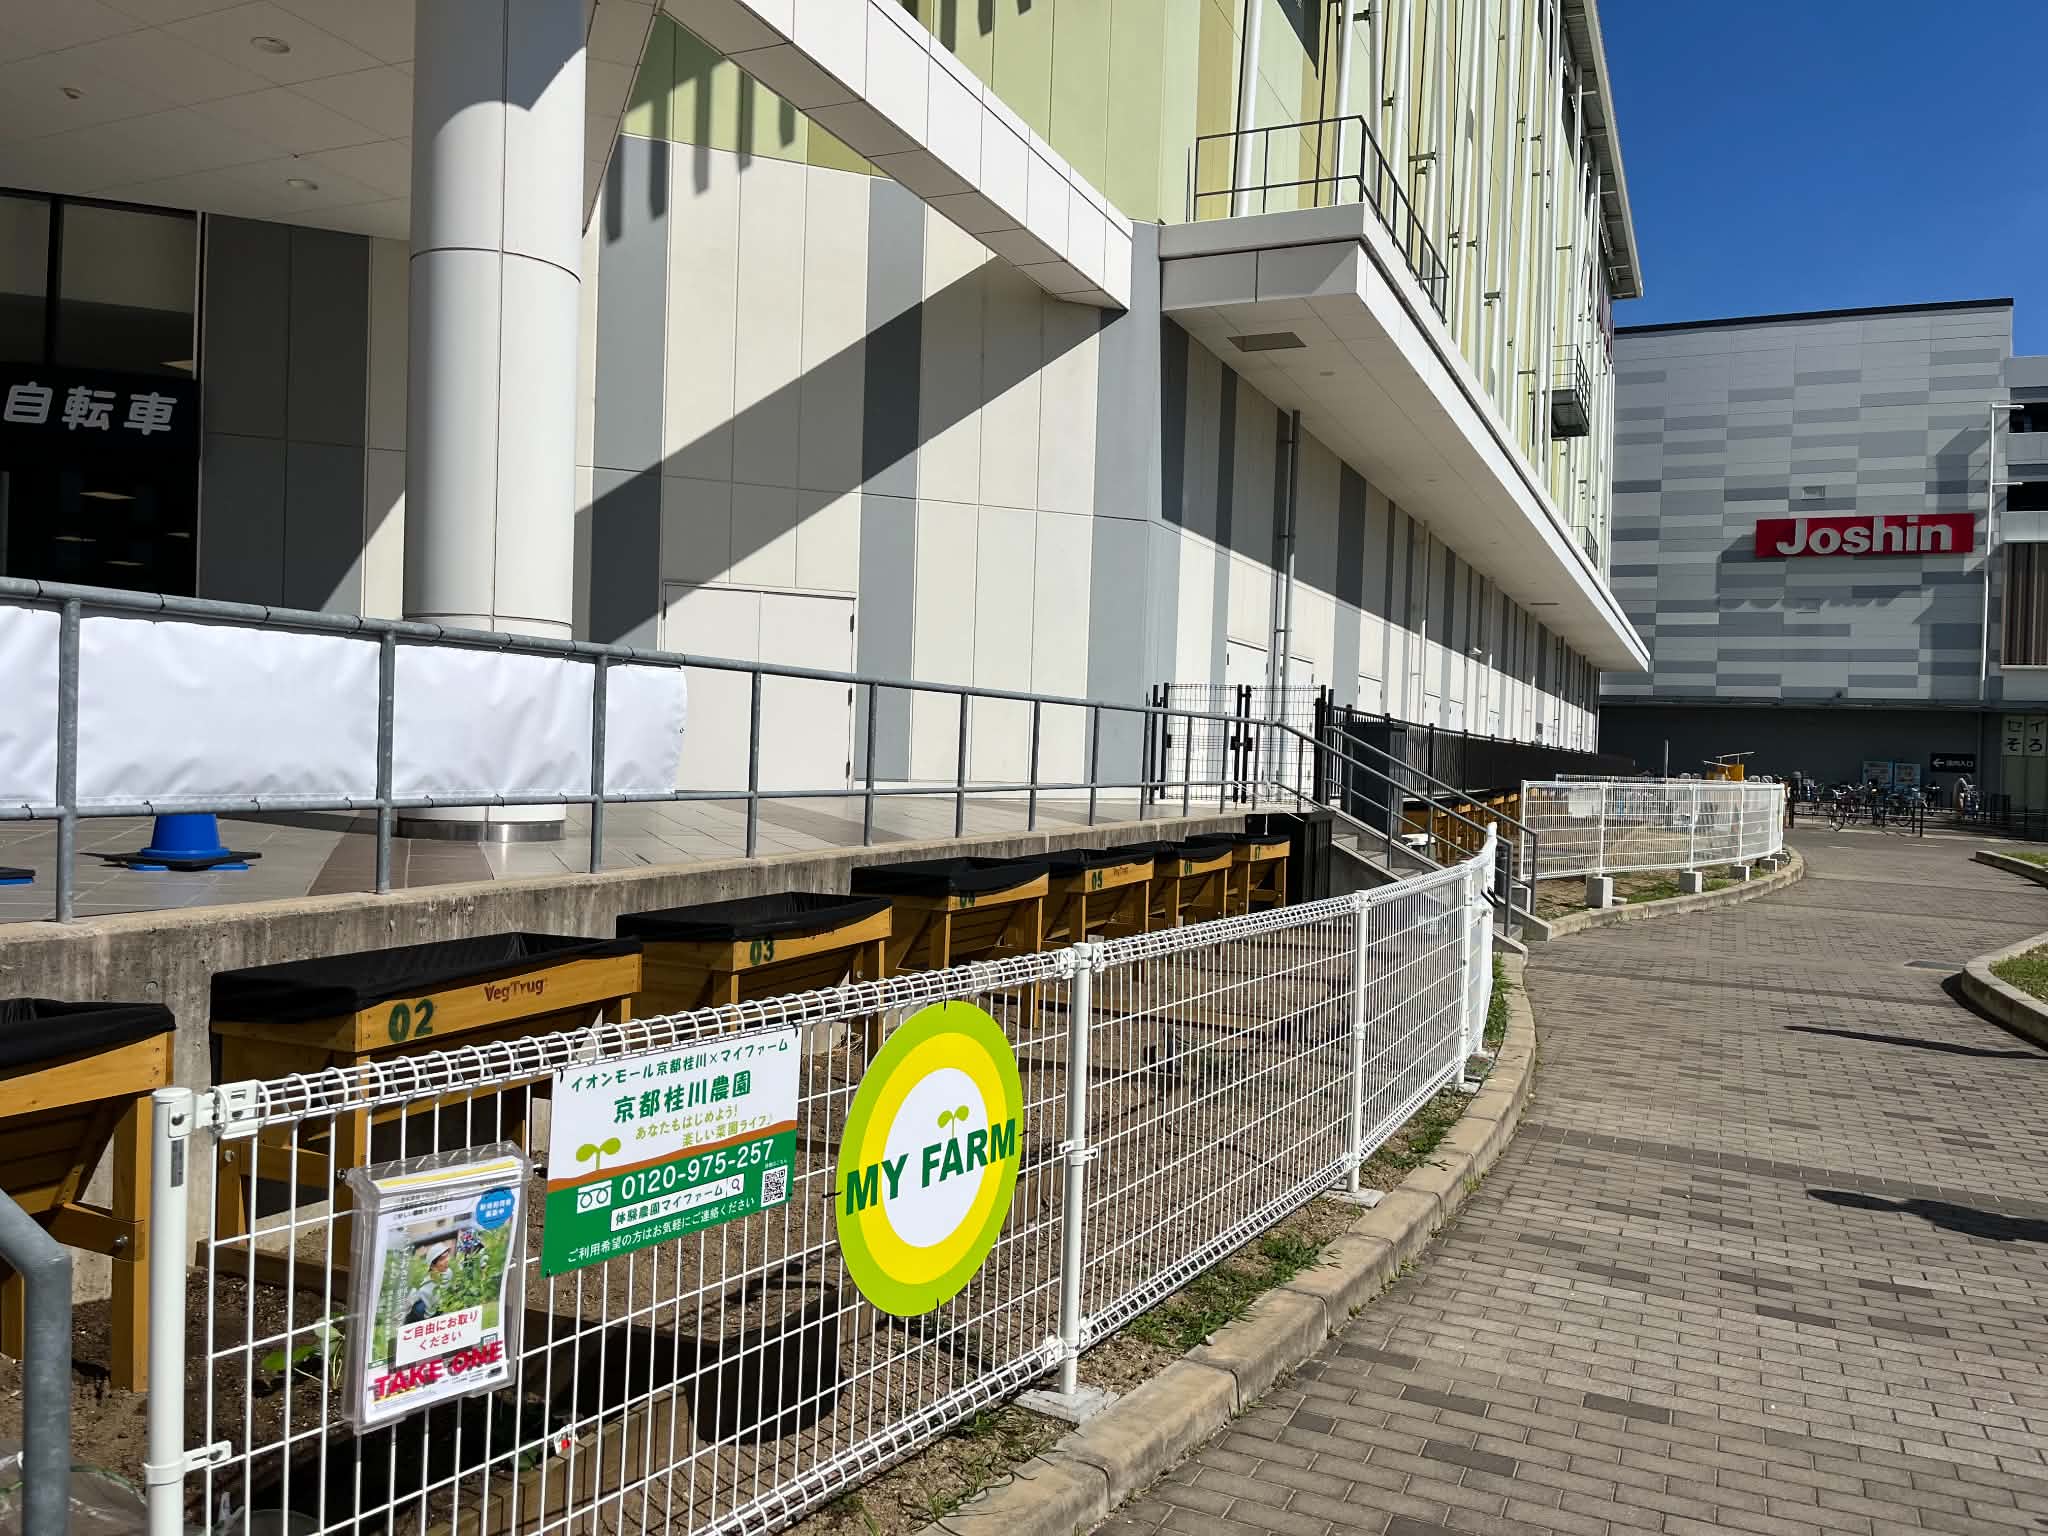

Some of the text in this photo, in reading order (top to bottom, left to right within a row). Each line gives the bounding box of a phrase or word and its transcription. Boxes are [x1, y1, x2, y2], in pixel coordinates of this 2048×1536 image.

[3, 381, 178, 436] 自転車
[1776, 515, 1953, 555] Joshin
[750, 938, 775, 965] 03
[484, 979, 545, 1002] VegTrug
[388, 998, 435, 1042] 02
[571, 1038, 788, 1093] イオンモール京都桂川×マイファーム
[613, 1070, 752, 1124] 京都桂川農園
[635, 1104, 738, 1140] あなたもはじめよう！
[621, 1138, 775, 1200] 0120-975-257
[845, 1118, 1016, 1215] MY FARM
[615, 1185, 723, 1226] 体験農園マイファーム
[567, 1197, 755, 1263] ご利用希望の方はお気軽にご連絡ください
[403, 1311, 479, 1341] ご自由にお取り
[419, 1331, 462, 1351] ください
[374, 1341, 504, 1397] TAKE ONE
